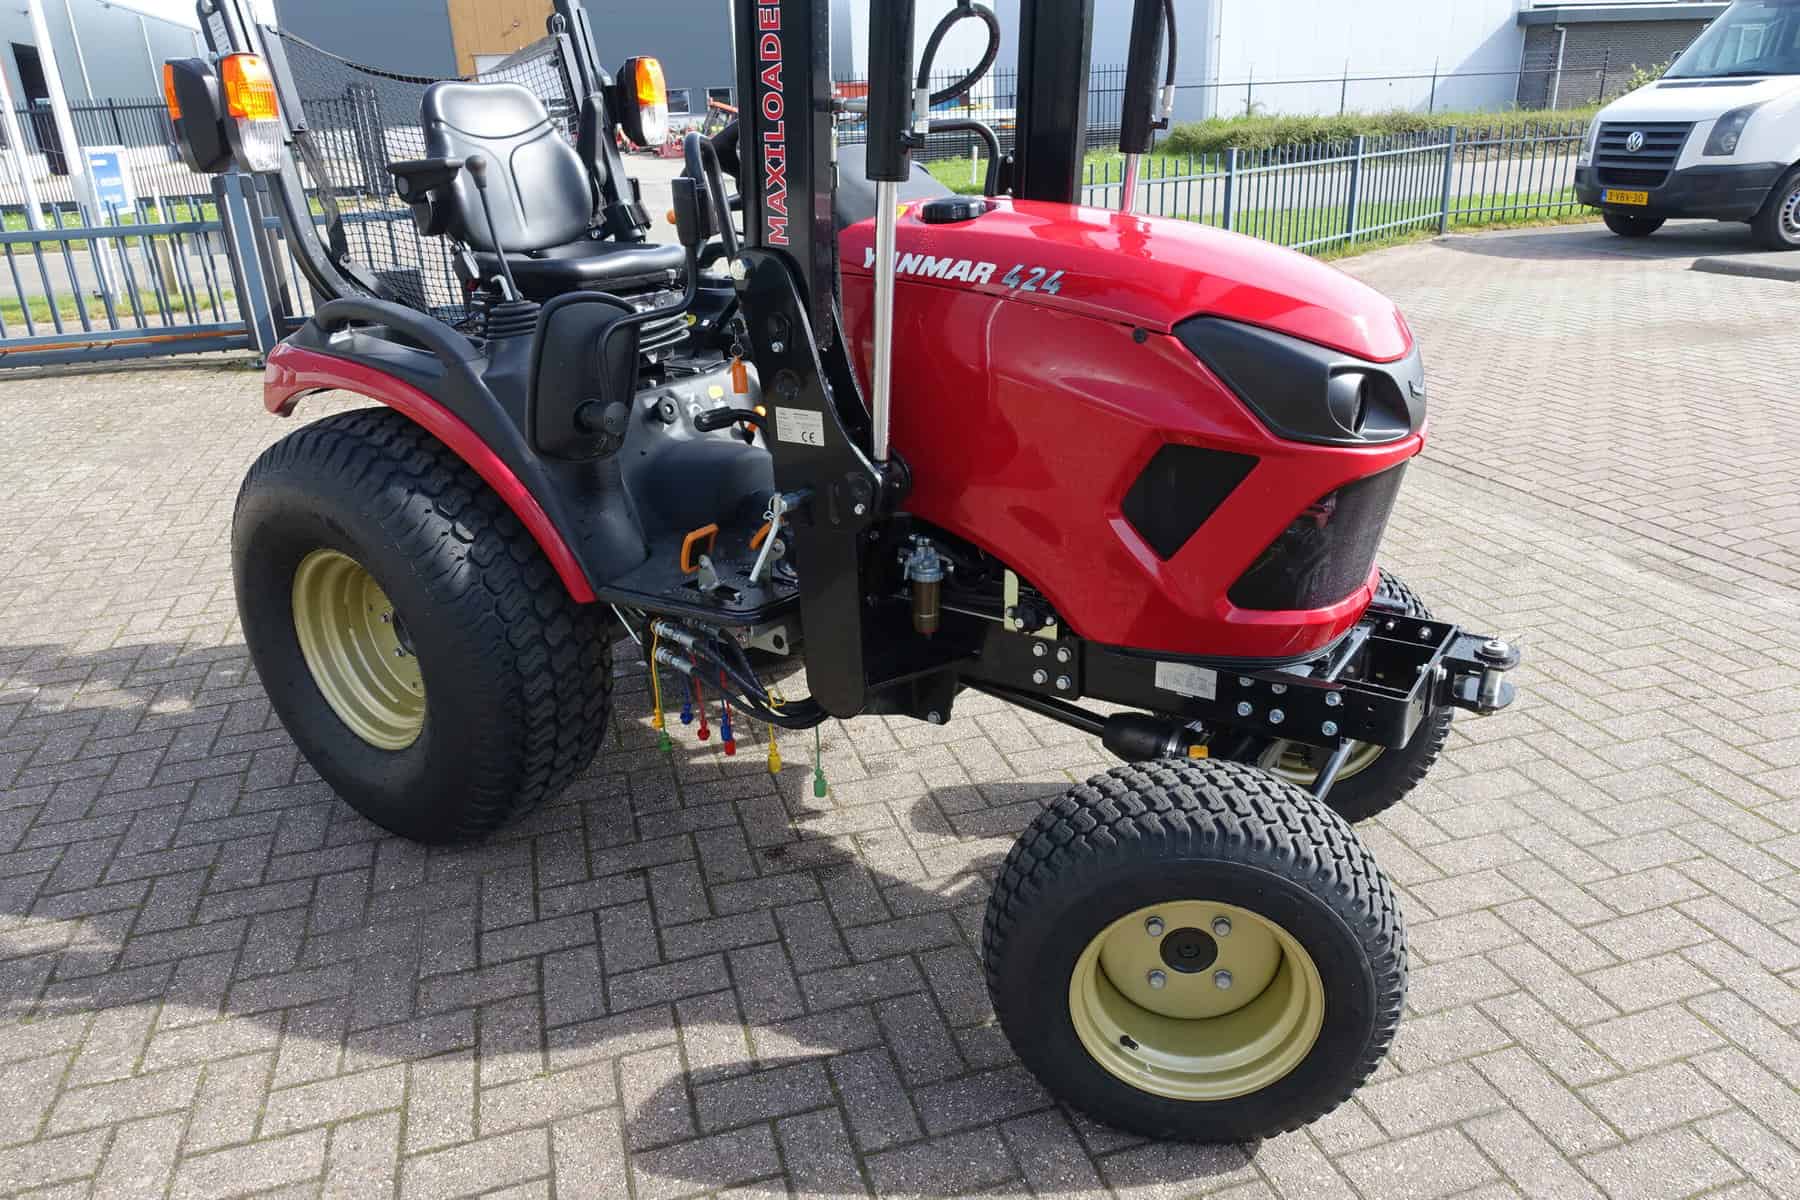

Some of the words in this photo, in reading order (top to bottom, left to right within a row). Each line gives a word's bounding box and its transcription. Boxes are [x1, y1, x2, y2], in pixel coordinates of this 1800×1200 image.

[758, 0, 789, 245] MAXILOADE
[863, 247, 996, 284] YNMAR
[1001, 264, 1065, 294] 424
